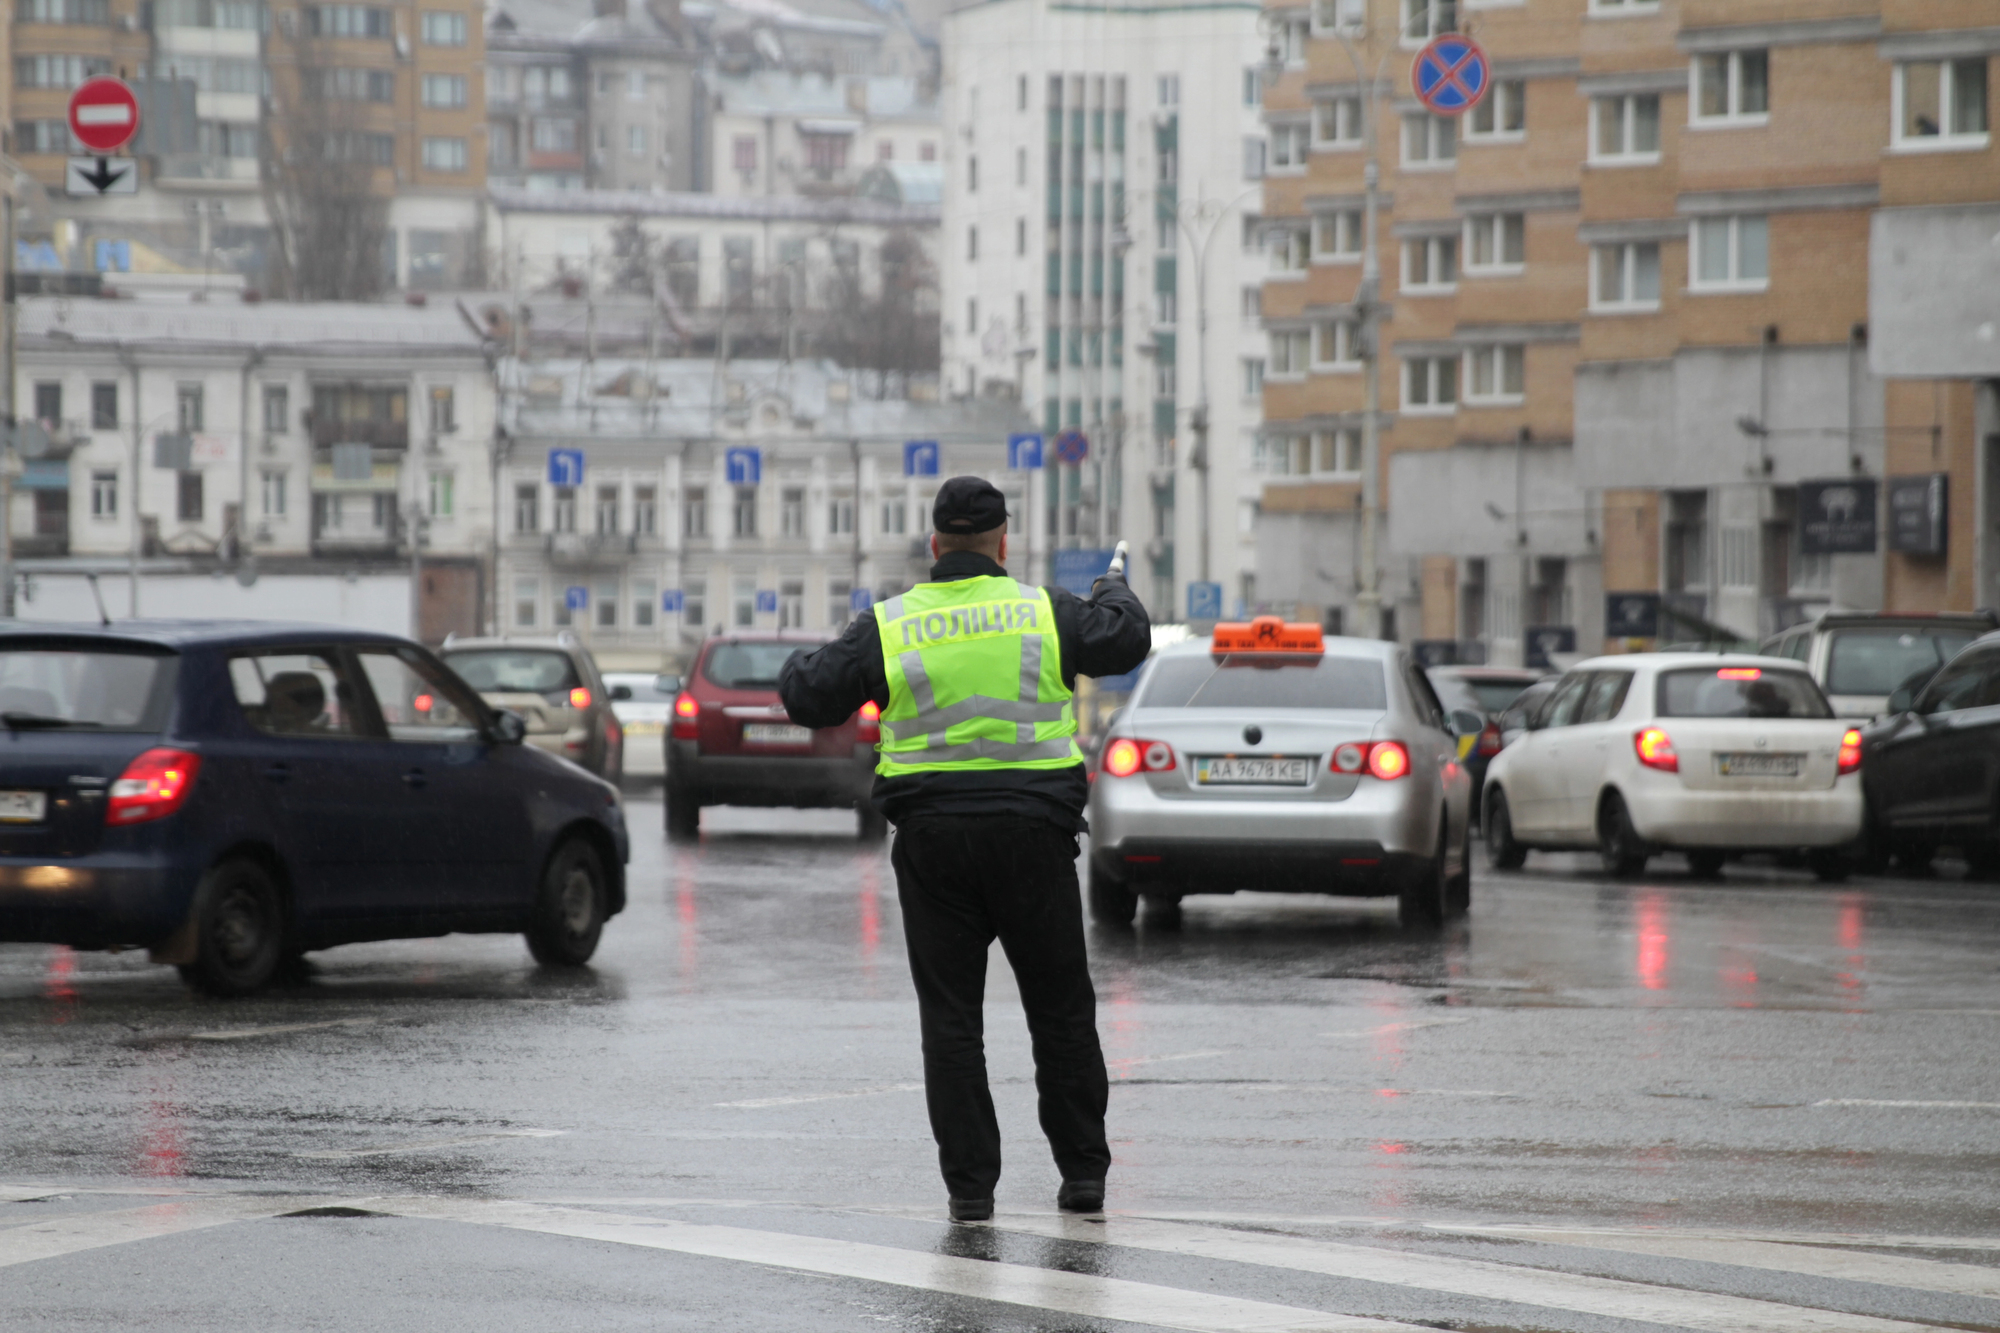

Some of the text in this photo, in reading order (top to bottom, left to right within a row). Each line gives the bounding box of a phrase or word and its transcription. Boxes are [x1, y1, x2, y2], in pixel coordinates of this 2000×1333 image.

[901, 603, 1037, 645] ПОЛІЦІЯ
[1210, 760, 1302, 778] AA 9678 KE
